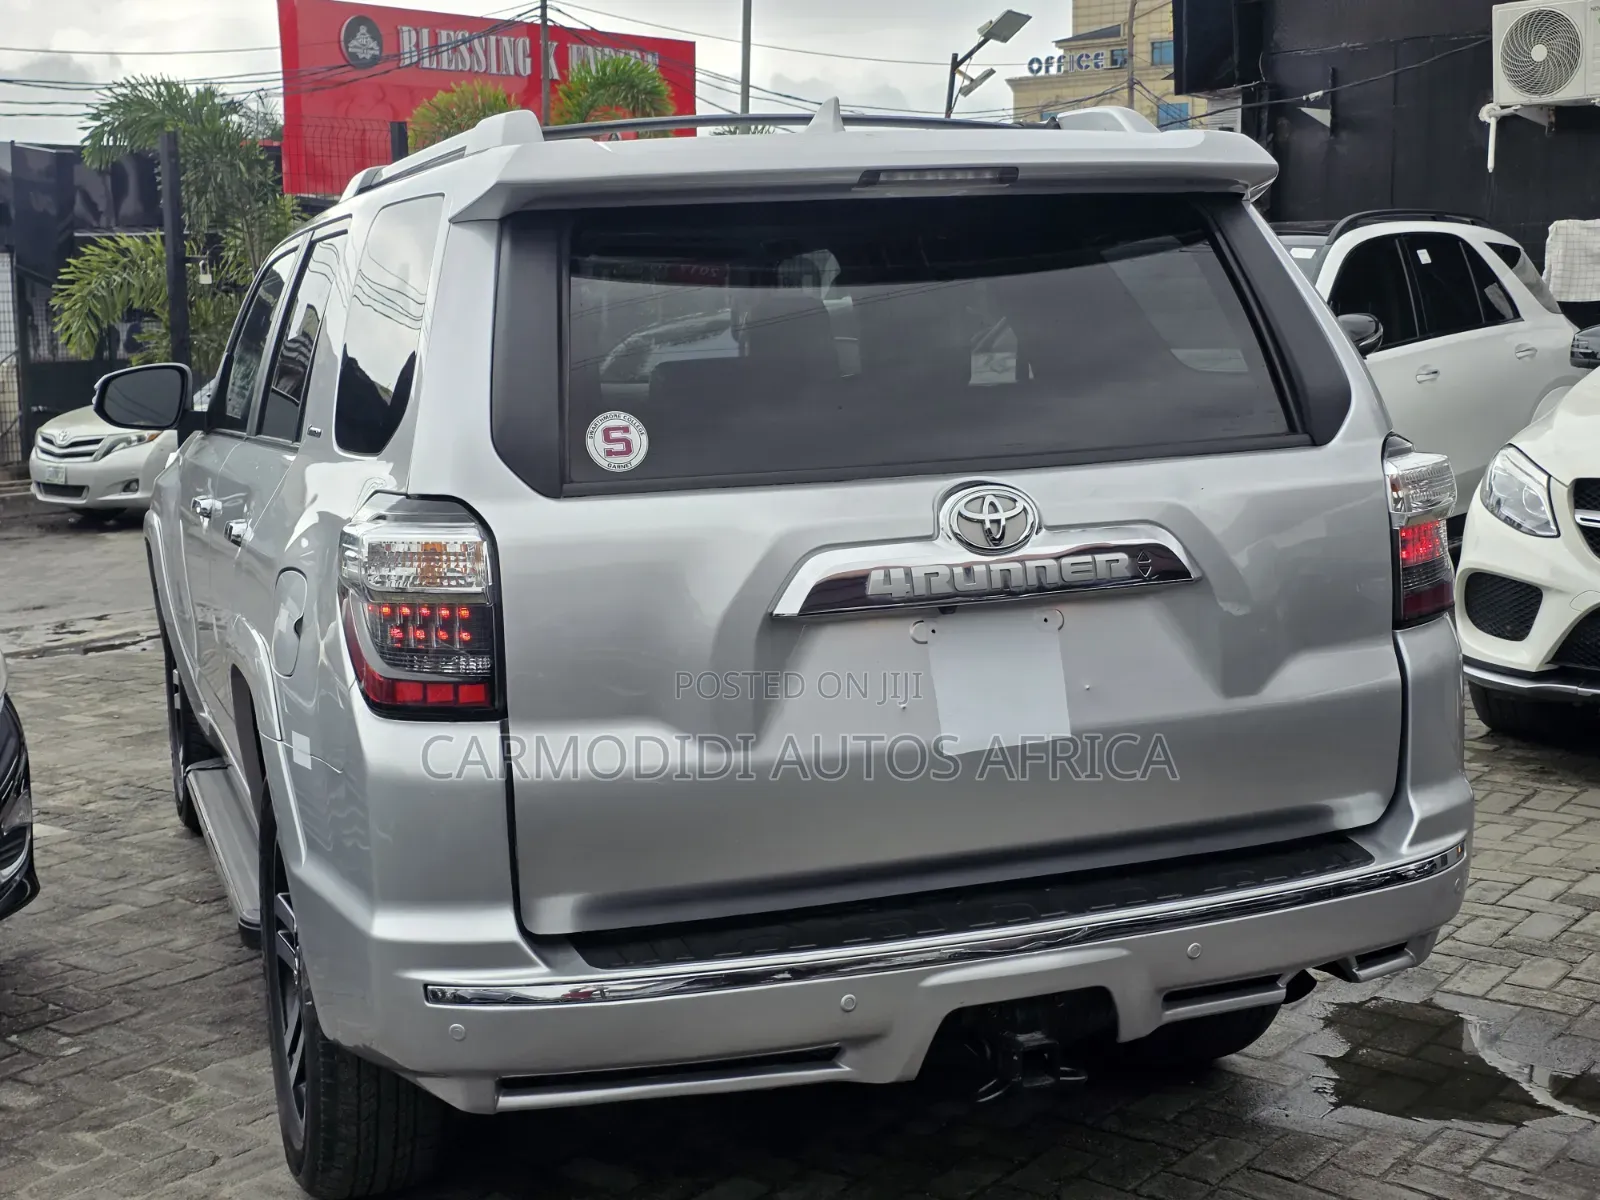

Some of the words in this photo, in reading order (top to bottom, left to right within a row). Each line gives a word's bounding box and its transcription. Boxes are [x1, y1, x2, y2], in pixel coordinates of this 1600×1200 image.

[397, 25, 532, 77] BLESSING
[1027, 52, 1105, 75] OFFICE
[623, 415, 645, 436] COLLEGE
[602, 425, 633, 458] S
[607, 462, 632, 470] GARNET
